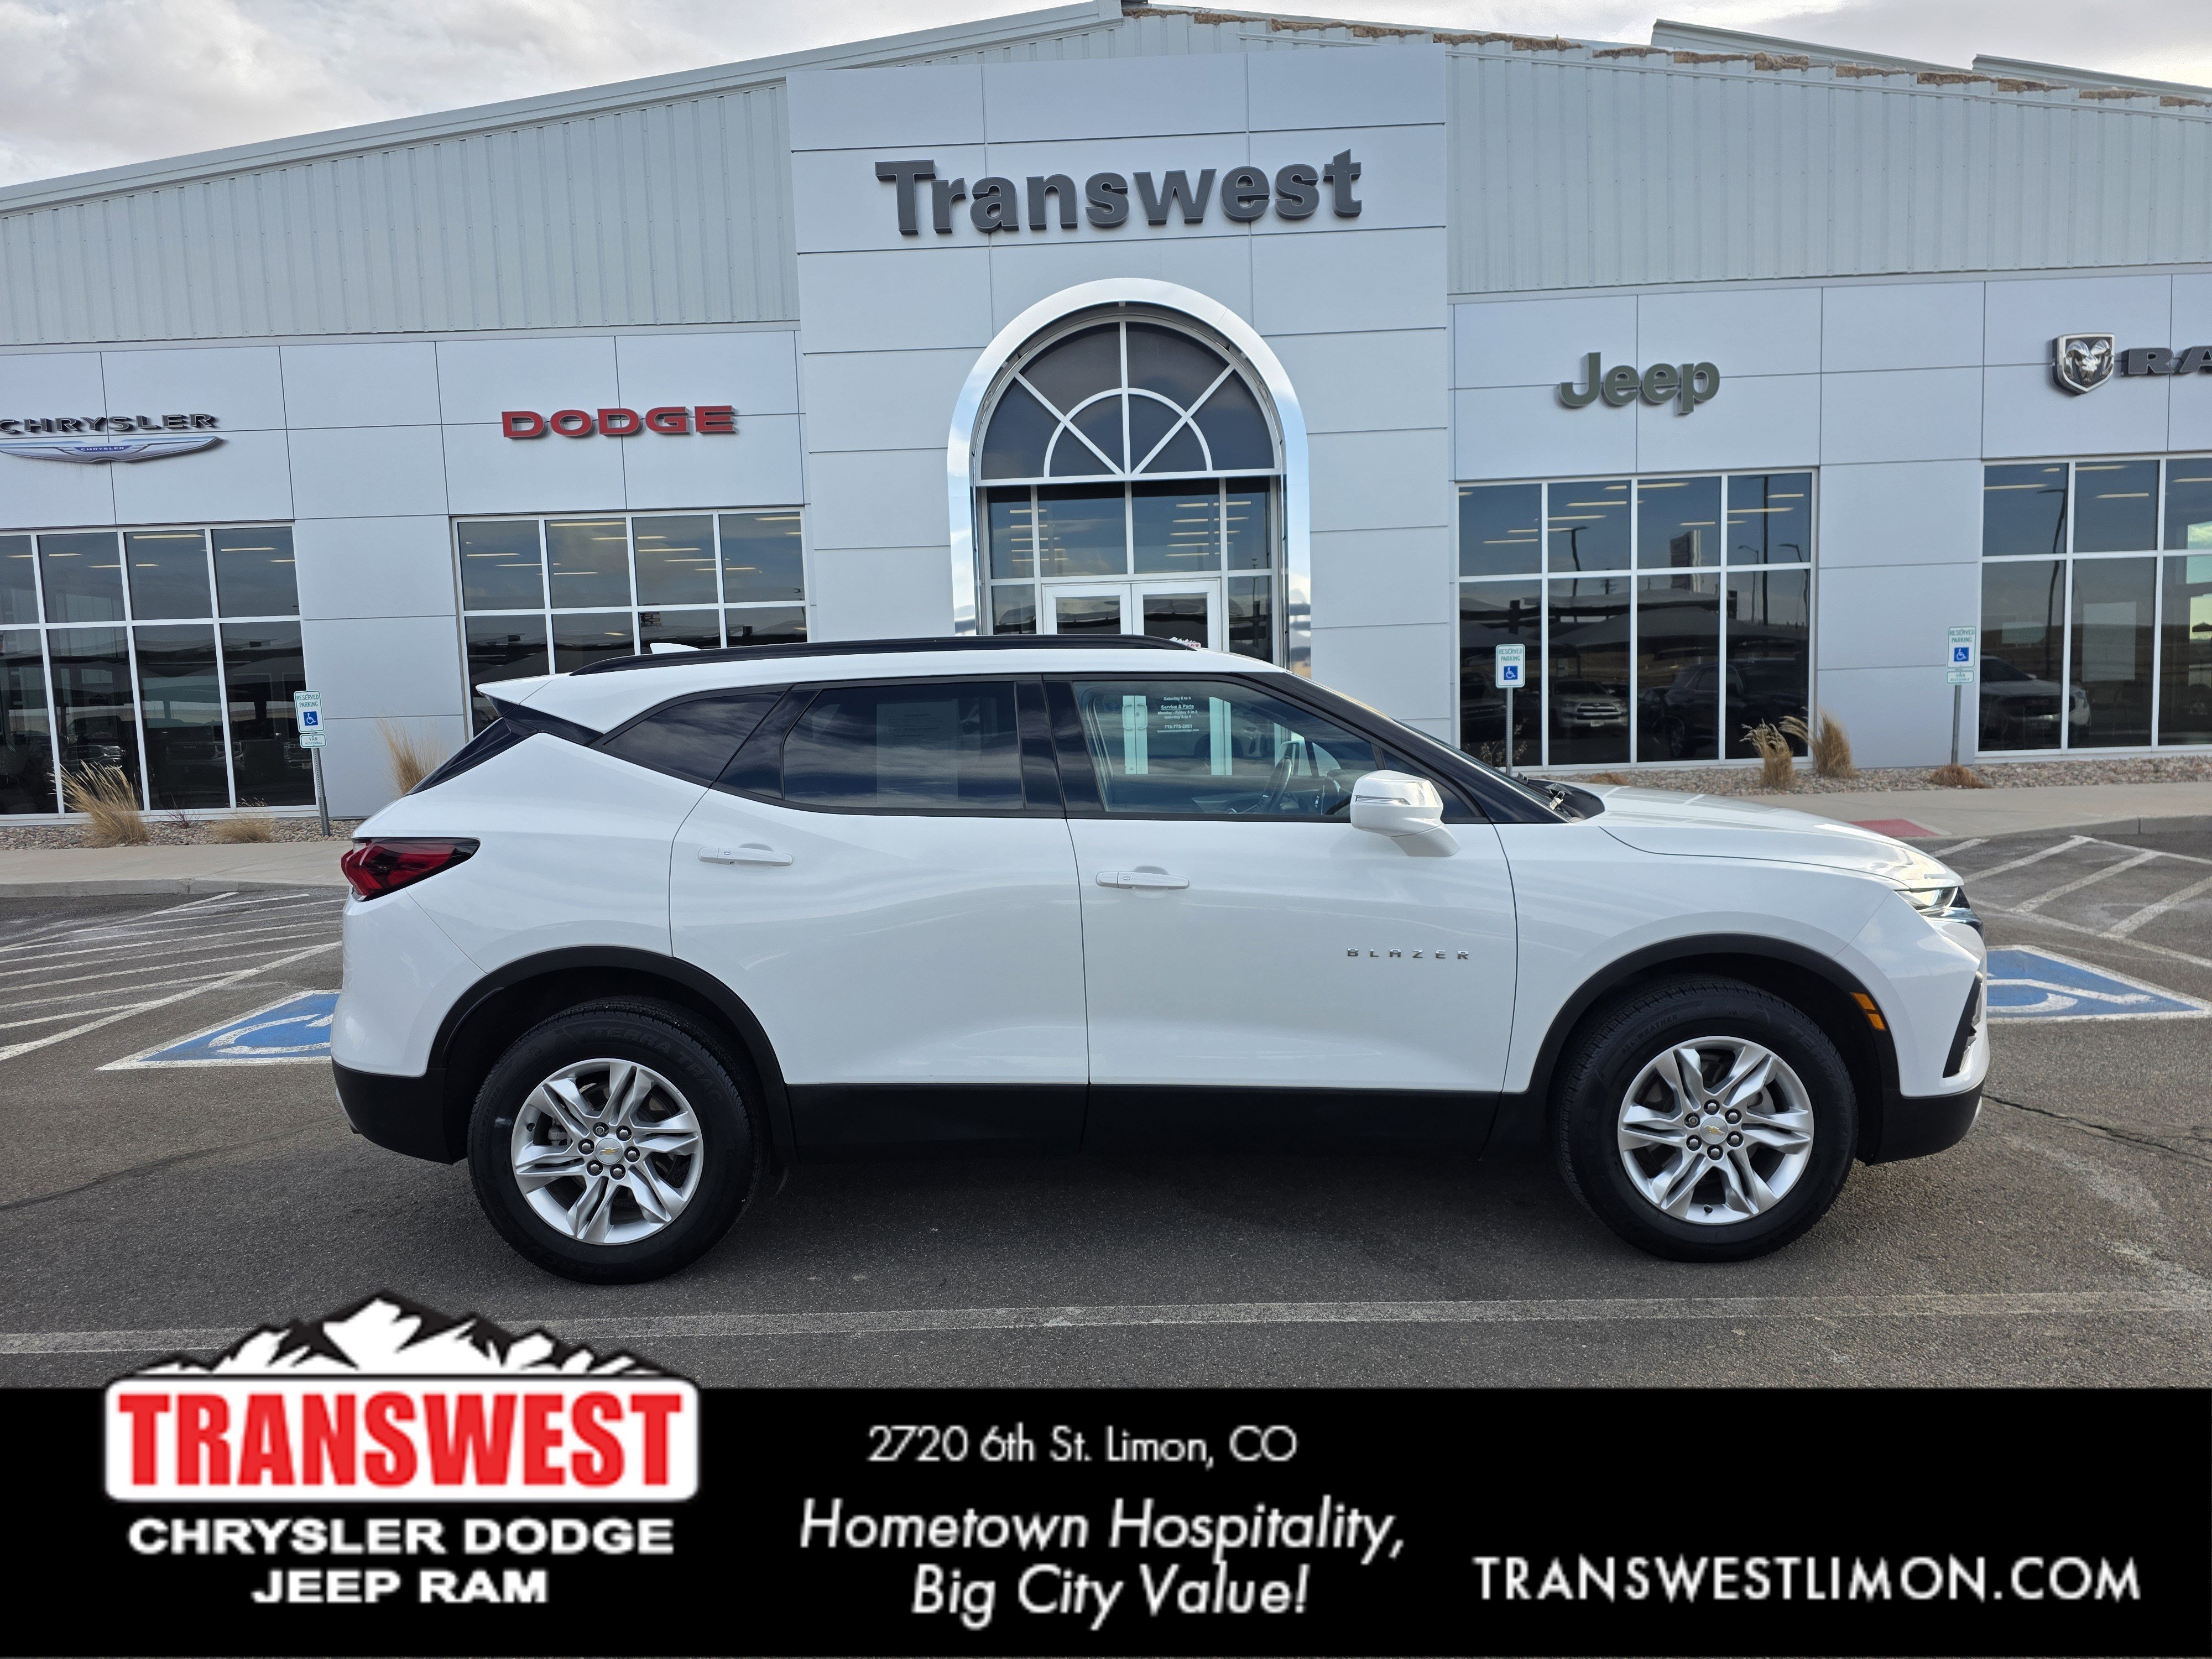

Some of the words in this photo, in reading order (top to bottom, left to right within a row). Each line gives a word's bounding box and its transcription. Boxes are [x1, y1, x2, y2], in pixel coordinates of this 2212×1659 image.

[875, 149, 1362, 234] Transwest
[1557, 352, 1720, 415] Jeep
[0, 413, 217, 434] CHRYSLER
[502, 405, 737, 438] DODGE
[1347, 947, 1469, 960] BLAZER
[591, 1026, 672, 1055] TERRA
[675, 1050, 726, 1104] TRAC
